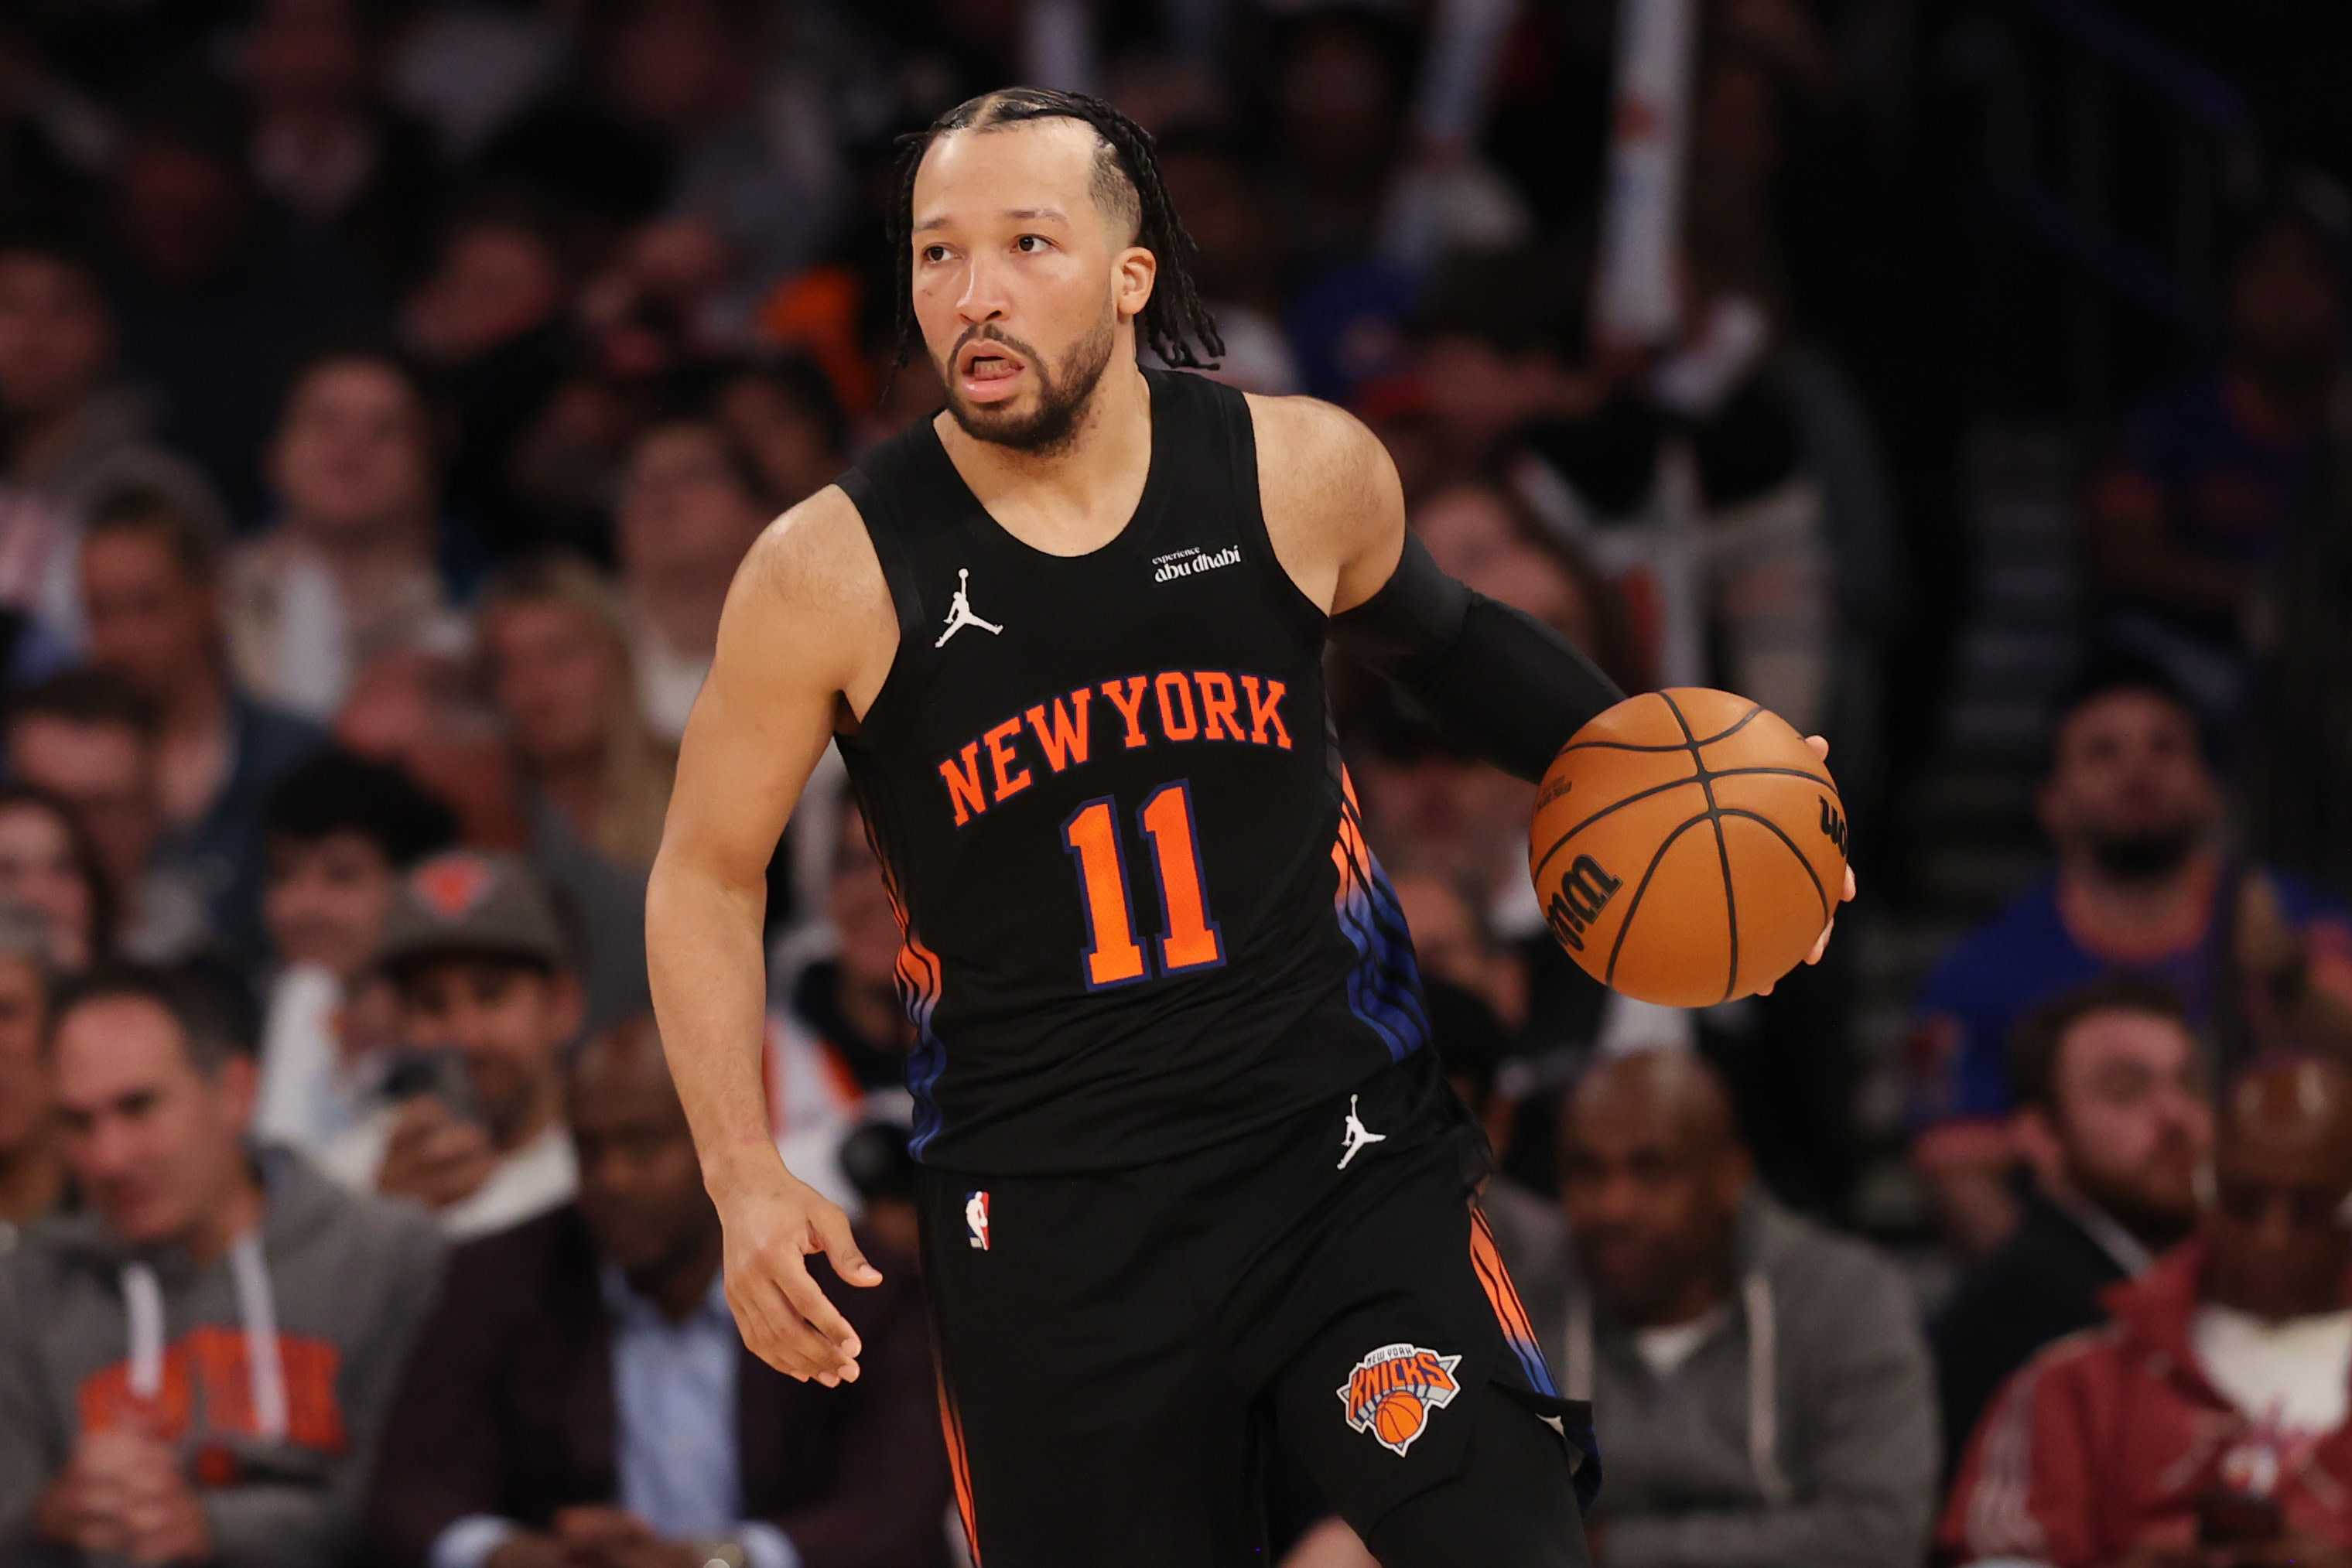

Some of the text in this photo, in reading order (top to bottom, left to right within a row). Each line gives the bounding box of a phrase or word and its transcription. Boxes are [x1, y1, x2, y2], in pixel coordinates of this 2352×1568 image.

[1151, 546, 1201, 565] experience
[1154, 545, 1242, 582] abu dhabi
[937, 670, 1294, 828] NEW YORK
[1060, 778, 1227, 992] 11
[1366, 1346, 1413, 1368] NEW YORK
[1349, 1351, 1456, 1421] KNICKS
